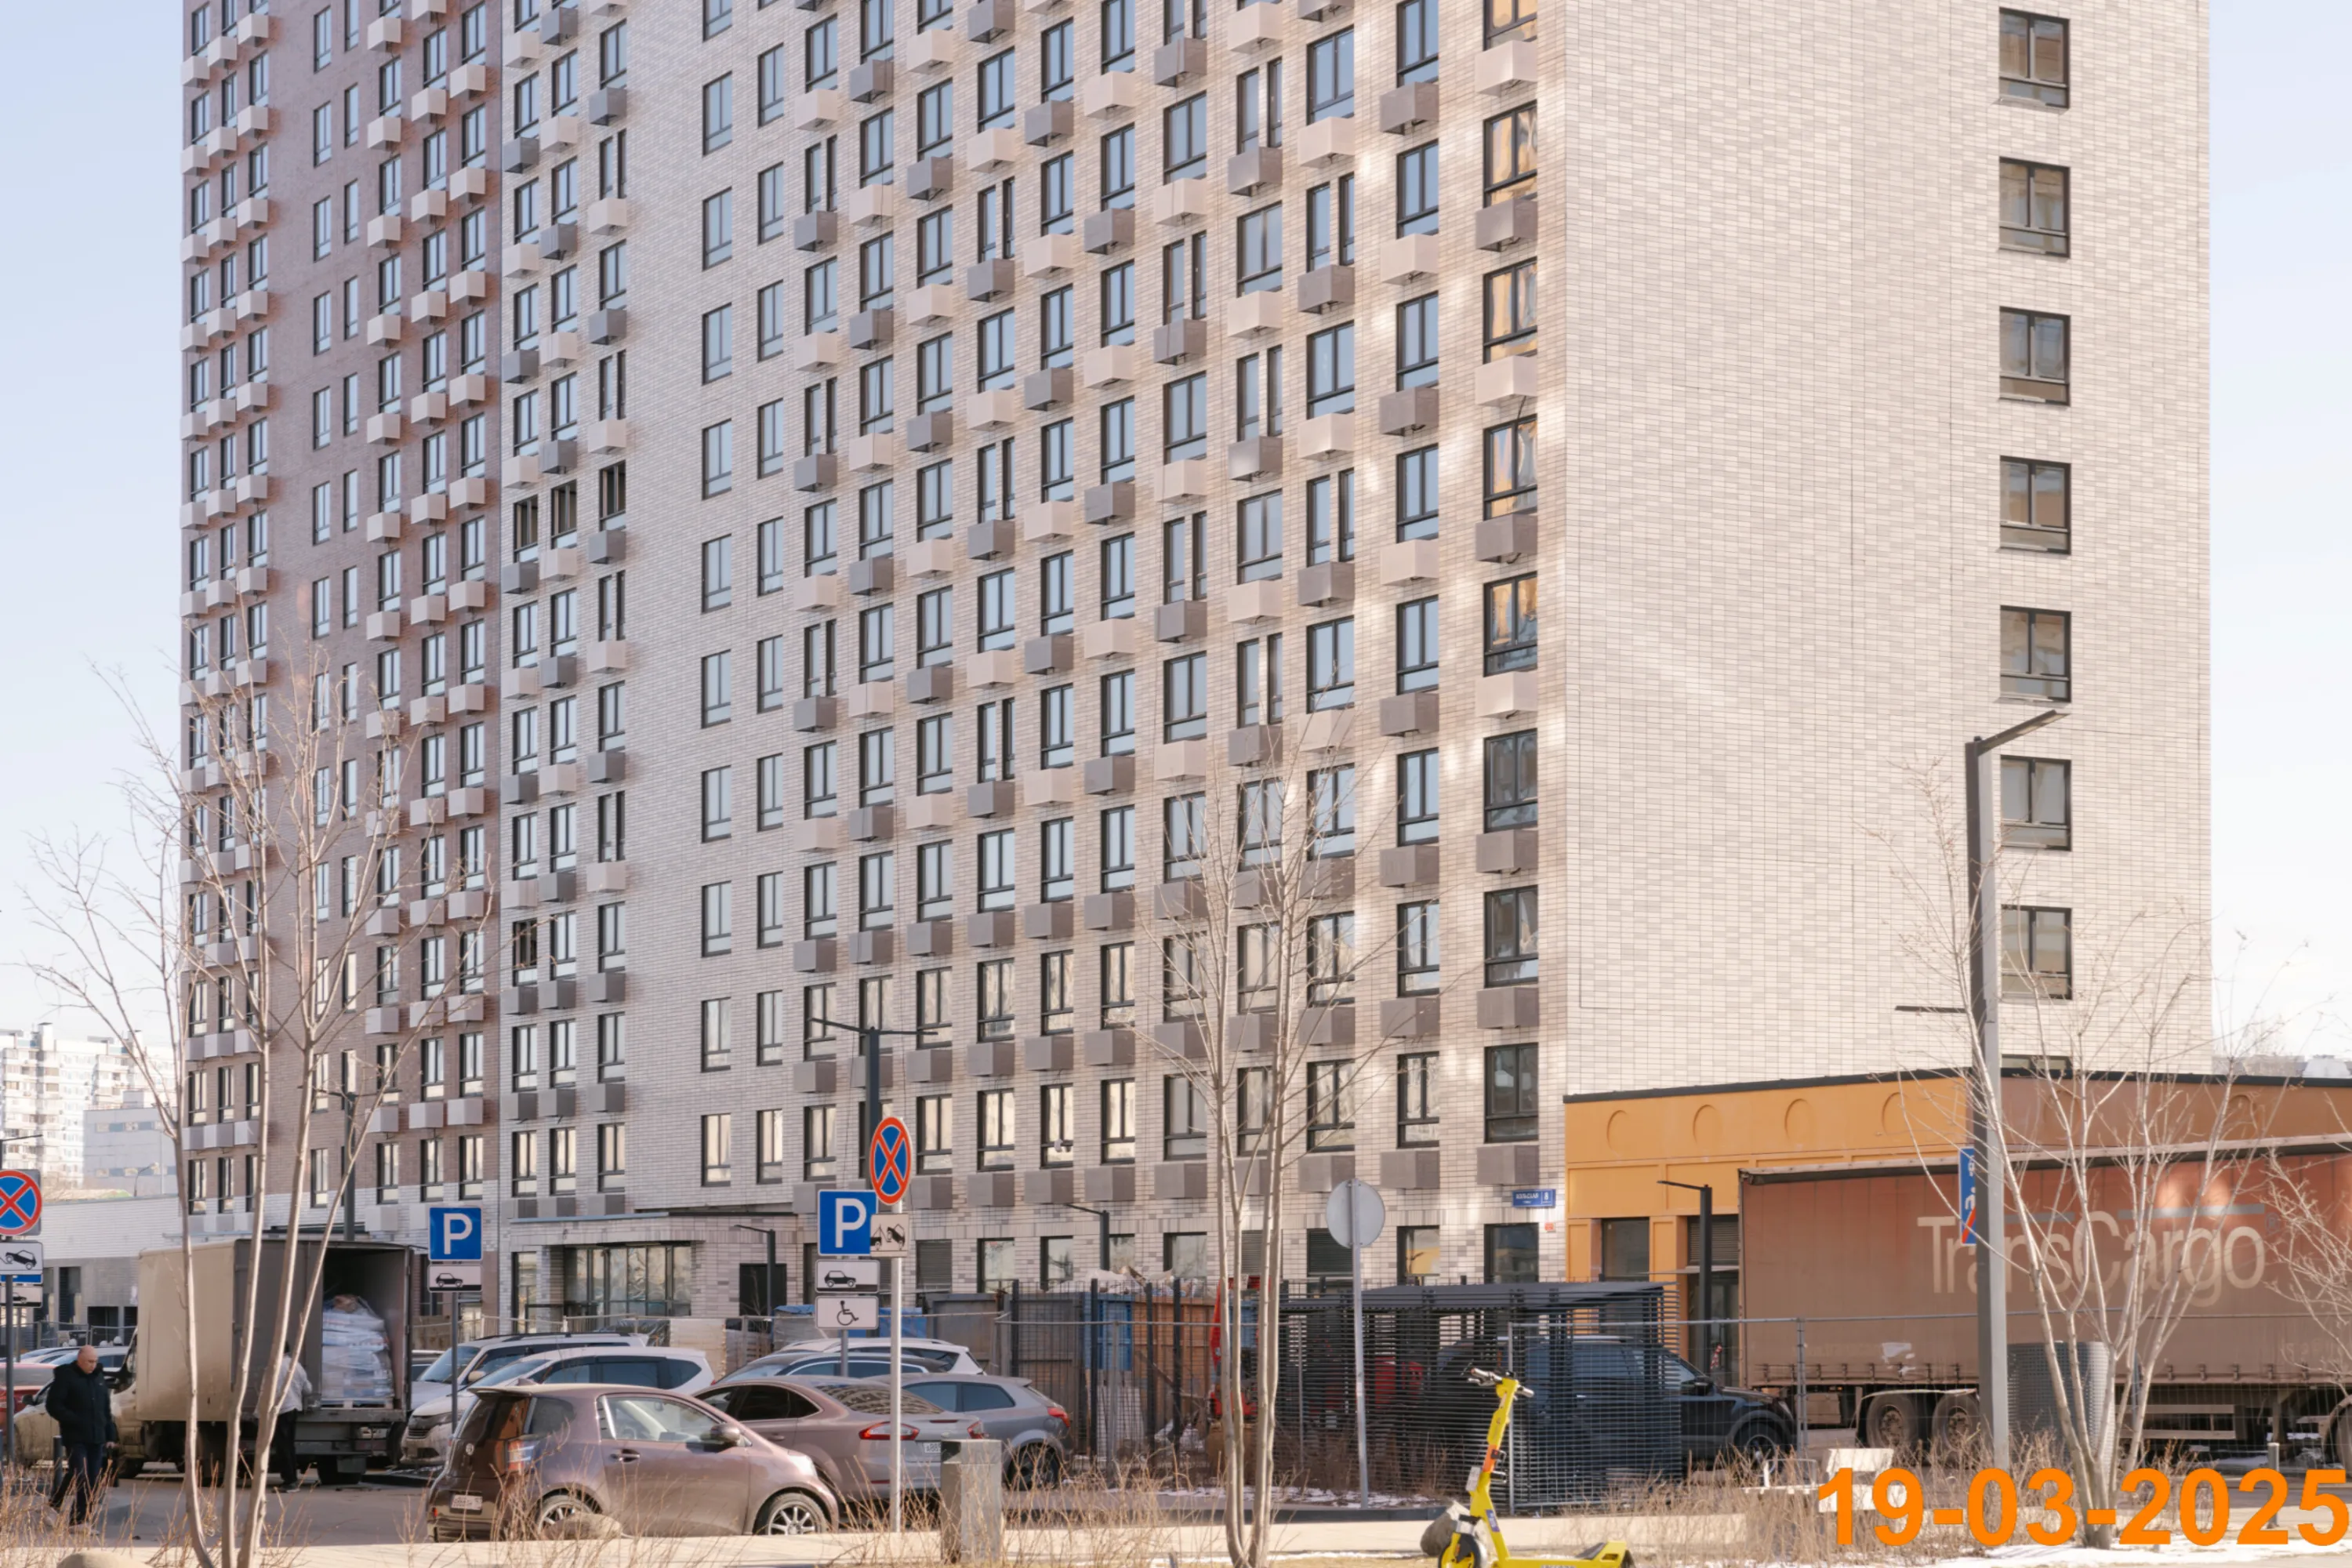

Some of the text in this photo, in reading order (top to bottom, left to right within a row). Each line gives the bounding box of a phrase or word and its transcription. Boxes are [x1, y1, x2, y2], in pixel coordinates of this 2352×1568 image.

[1544, 1192, 1549, 1200] 8
[443, 1213, 472, 1254] P
[835, 1198, 866, 1248] P
[1917, 1210, 2265, 1308] TrnsCargo
